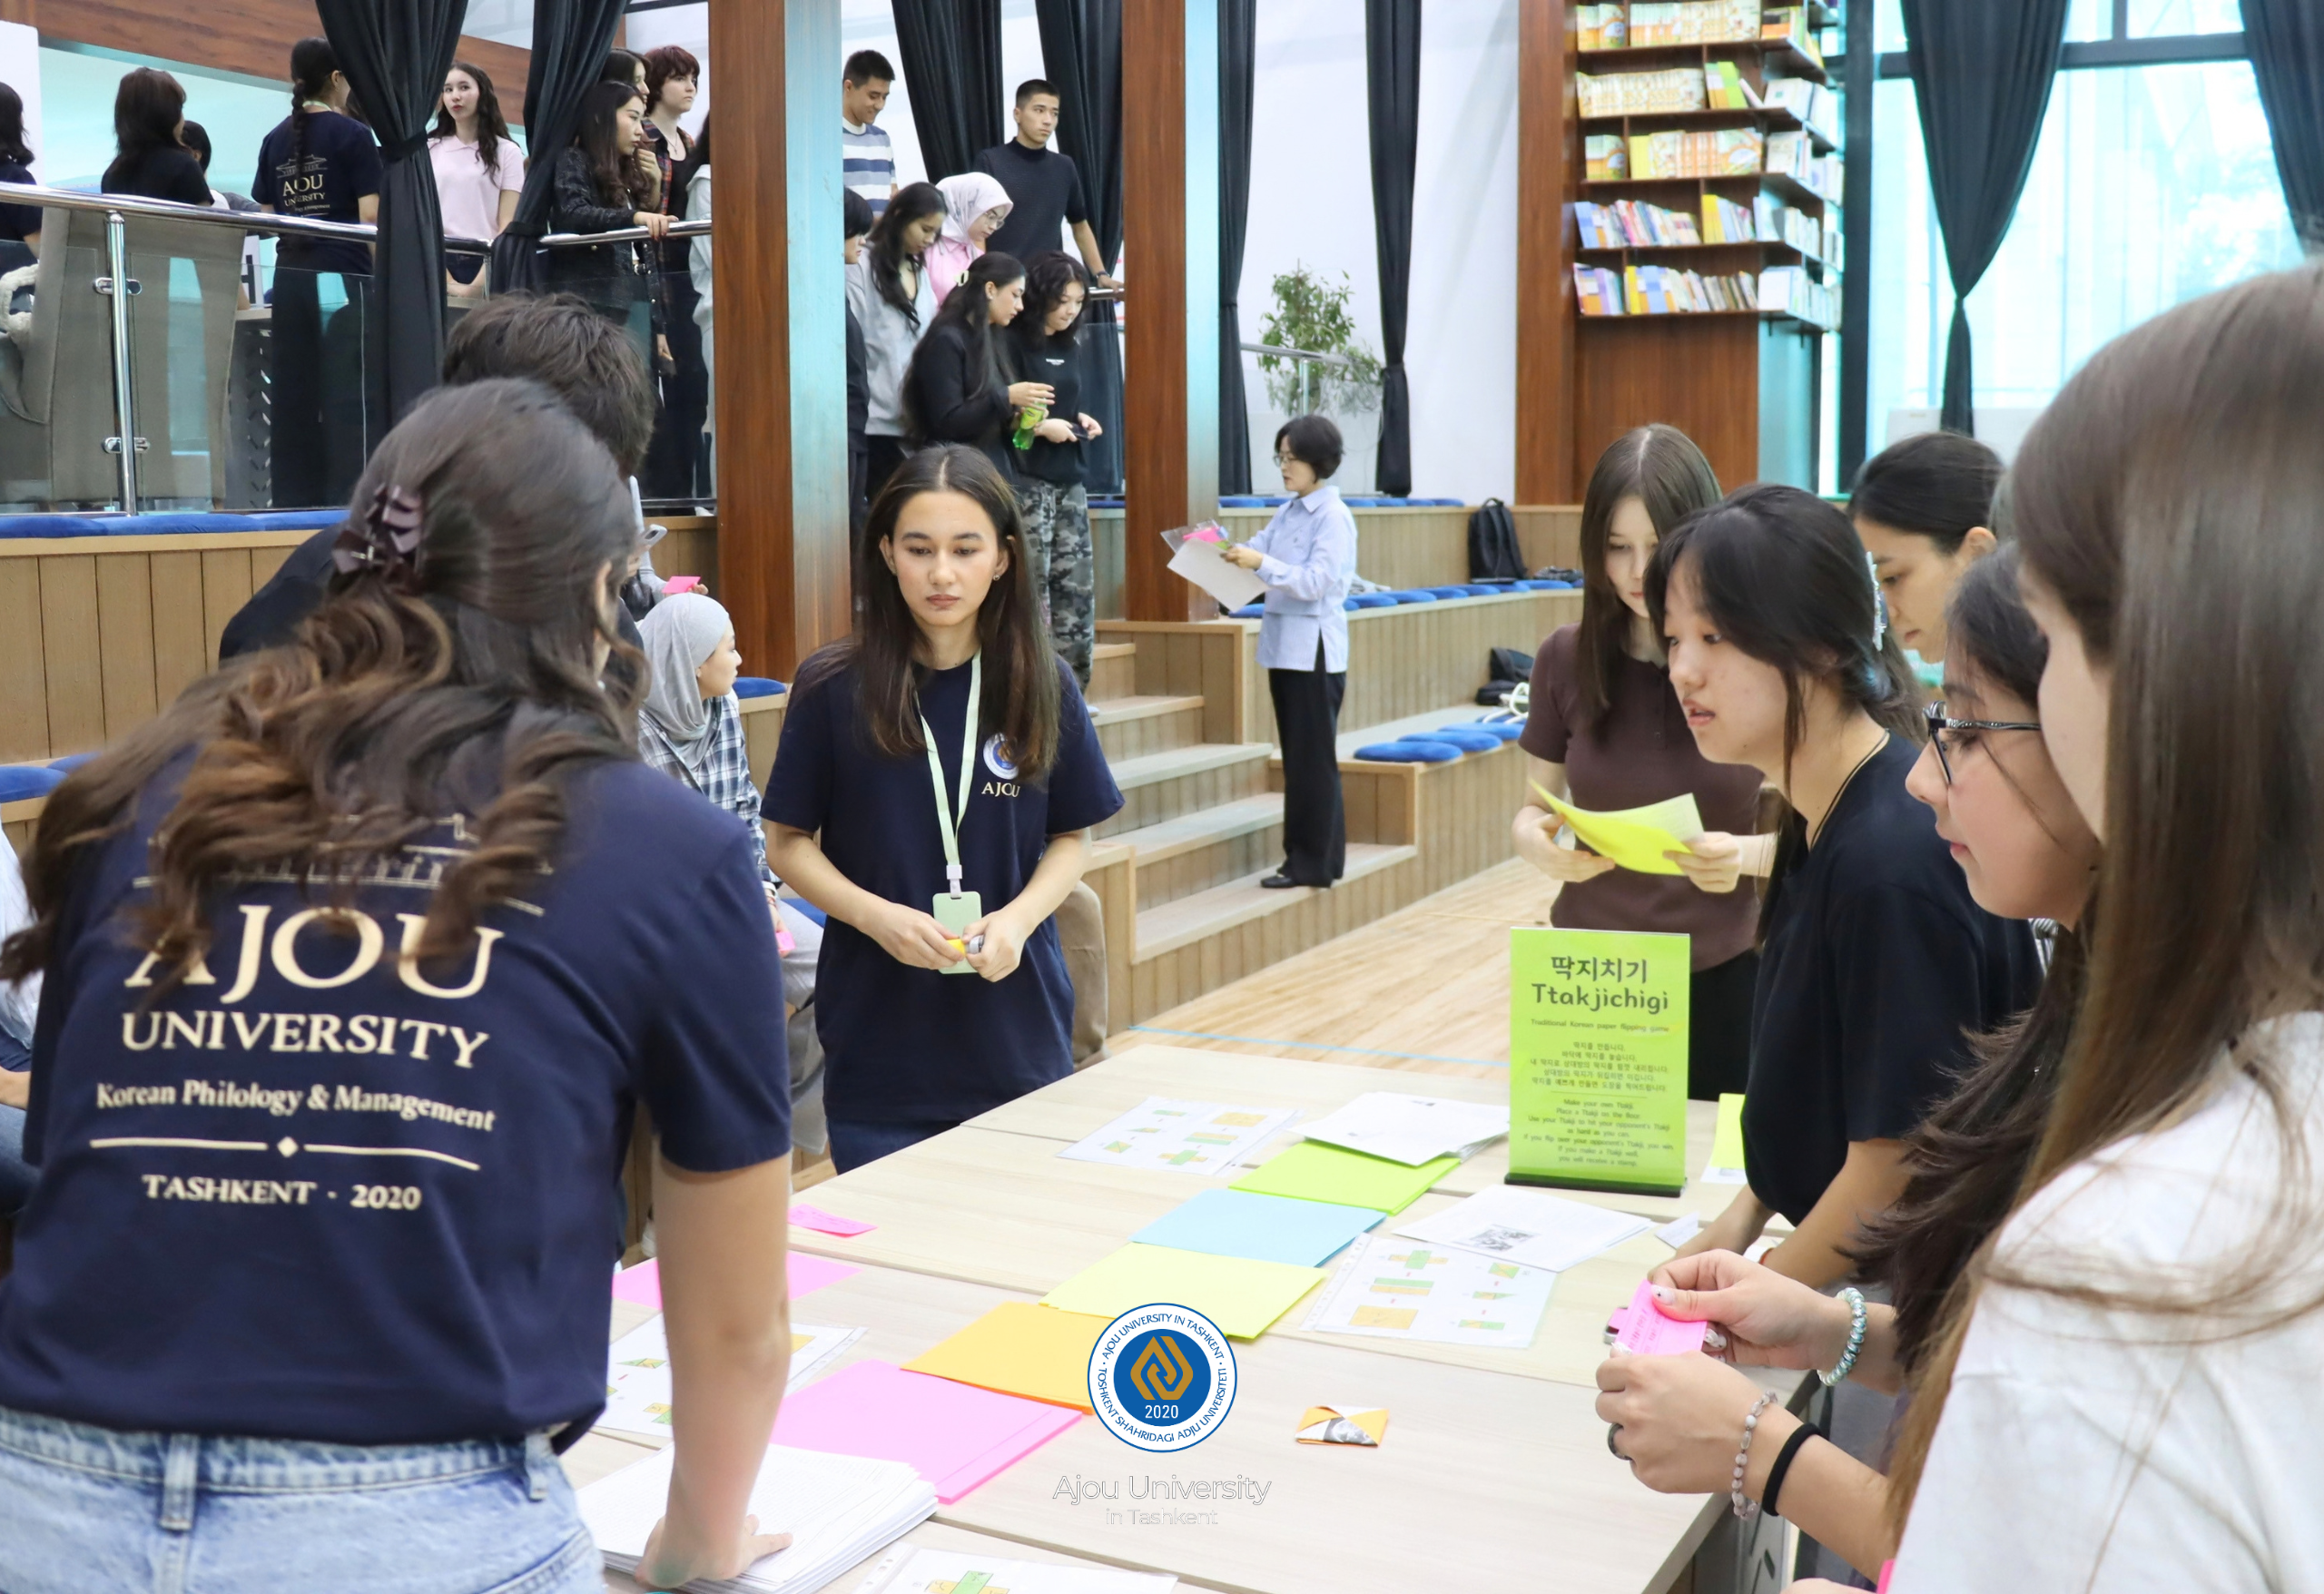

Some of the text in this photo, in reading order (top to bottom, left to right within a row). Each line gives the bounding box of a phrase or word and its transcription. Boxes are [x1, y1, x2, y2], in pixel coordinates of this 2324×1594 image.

[283, 174, 323, 196] AOU
[981, 782, 1020, 798] AJOU
[1551, 956, 1647, 984] 딱지치기
[1531, 983, 1669, 1015] Ttakjichigi
[1531, 1018, 1567, 1027] Traditional
[1570, 1020, 1594, 1028] Korean
[1597, 1023, 1617, 1031] paper
[1620, 1023, 1647, 1033] flipping
[122, 1010, 489, 1068] UNIVERSITY
[1573, 1041, 1593, 1051] 딱지를
[1561, 1050, 1581, 1059] 바닥에
[1585, 1052, 1605, 1061] 딱지를
[97, 1080, 496, 1132] Korean Philology & Management
[1556, 1107, 1572, 1116] Place
[1563, 1098, 1581, 1107] Make
[142, 1175, 318, 1205] TASHKENT
[350, 1184, 422, 1210] 2020
